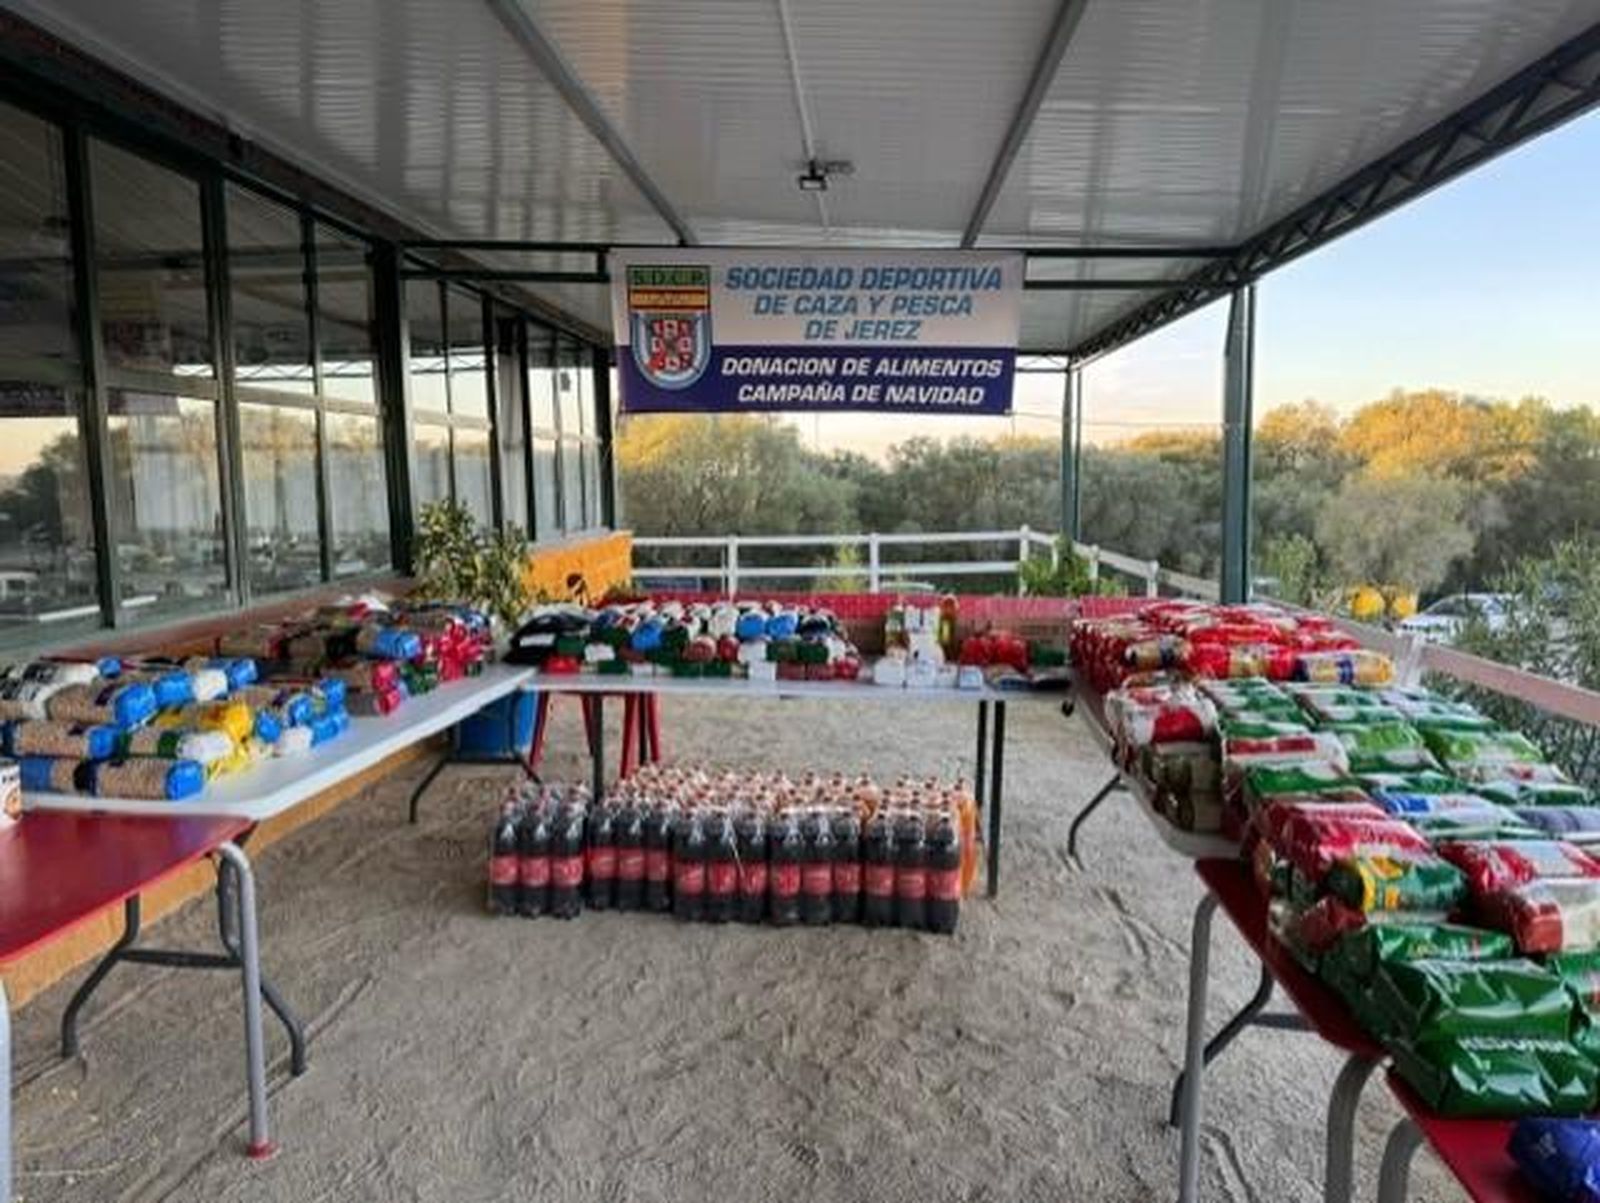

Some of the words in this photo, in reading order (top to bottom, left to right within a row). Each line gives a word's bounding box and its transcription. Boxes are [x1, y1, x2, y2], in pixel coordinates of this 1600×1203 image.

[725, 267, 853, 291] SOCIEDAD
[859, 267, 1002, 291] DEPORTIVA
[754, 296, 785, 315] DE
[792, 296, 857, 316] CAZA
[870, 296, 885, 316] Y
[890, 296, 972, 317] PESCA
[804, 320, 838, 340] DE
[844, 321, 922, 341] JEREZ
[721, 357, 837, 377] DONACION
[841, 358, 870, 377] DE
[874, 359, 1003, 378] ALIMENTOS
[738, 381, 847, 403] CAMPAÑA
[851, 384, 882, 403] DE
[884, 385, 986, 406] NAVIDAD
